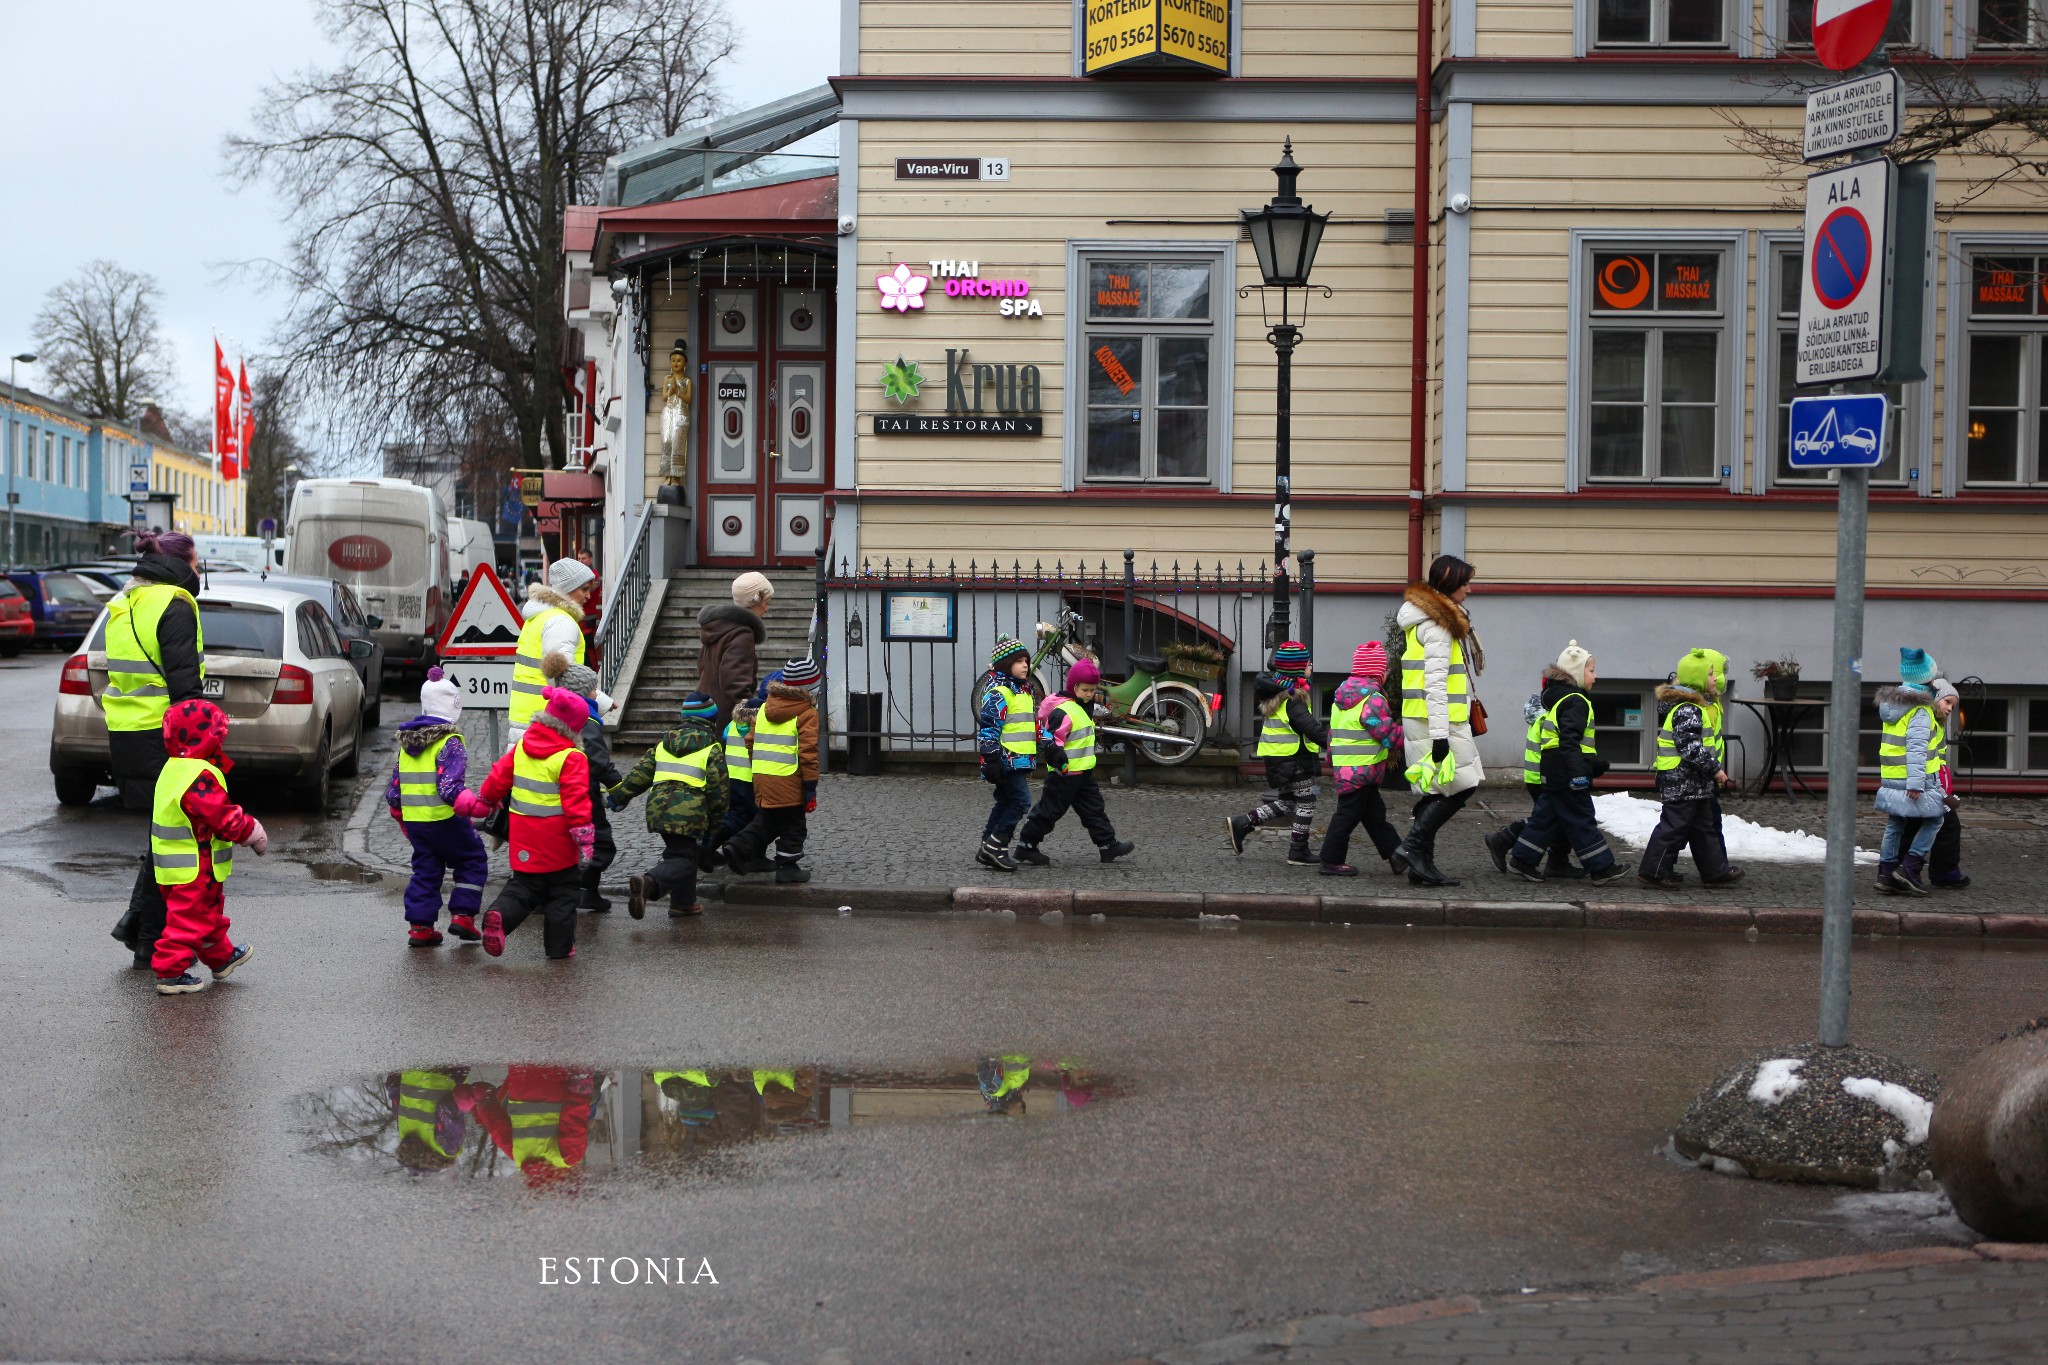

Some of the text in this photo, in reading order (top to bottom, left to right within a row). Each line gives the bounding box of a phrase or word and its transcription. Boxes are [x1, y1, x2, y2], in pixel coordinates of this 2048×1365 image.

[1088, 23, 1154, 60] 5670 5562
[1163, 23, 1226, 59] 5670 5562
[1816, 81, 1881, 107] VÄLJA ARVATUD
[1812, 110, 1883, 137] JA KINNISTUTELE
[1807, 124, 1888, 152] LIIKUVAD SÕIDUKID
[907, 163, 1004, 176] Vana-Viru 13
[1828, 177, 1861, 205] ALA
[928, 259, 979, 278] THAI
[1677, 265, 1700, 282] THAI
[1992, 270, 2015, 285] THAI
[944, 279, 1030, 297] ORCHID
[1108, 274, 1130, 289] THAI
[1665, 280, 1710, 298] MASSAAŽ
[1098, 288, 1140, 306] MASSAAŽ
[1000, 298, 1043, 316] SPA
[1808, 311, 1869, 332] VÄLJA ARVATUD
[1805, 327, 1870, 347] SÕIDUKID LINNA-
[1094, 345, 1136, 396] KOSMEETIK
[1809, 357, 1863, 375] ERILUBADEGA
[945, 348, 1042, 413] Krua
[719, 388, 746, 398] OPEN
[879, 419, 1016, 431] TAI RESTORAN
